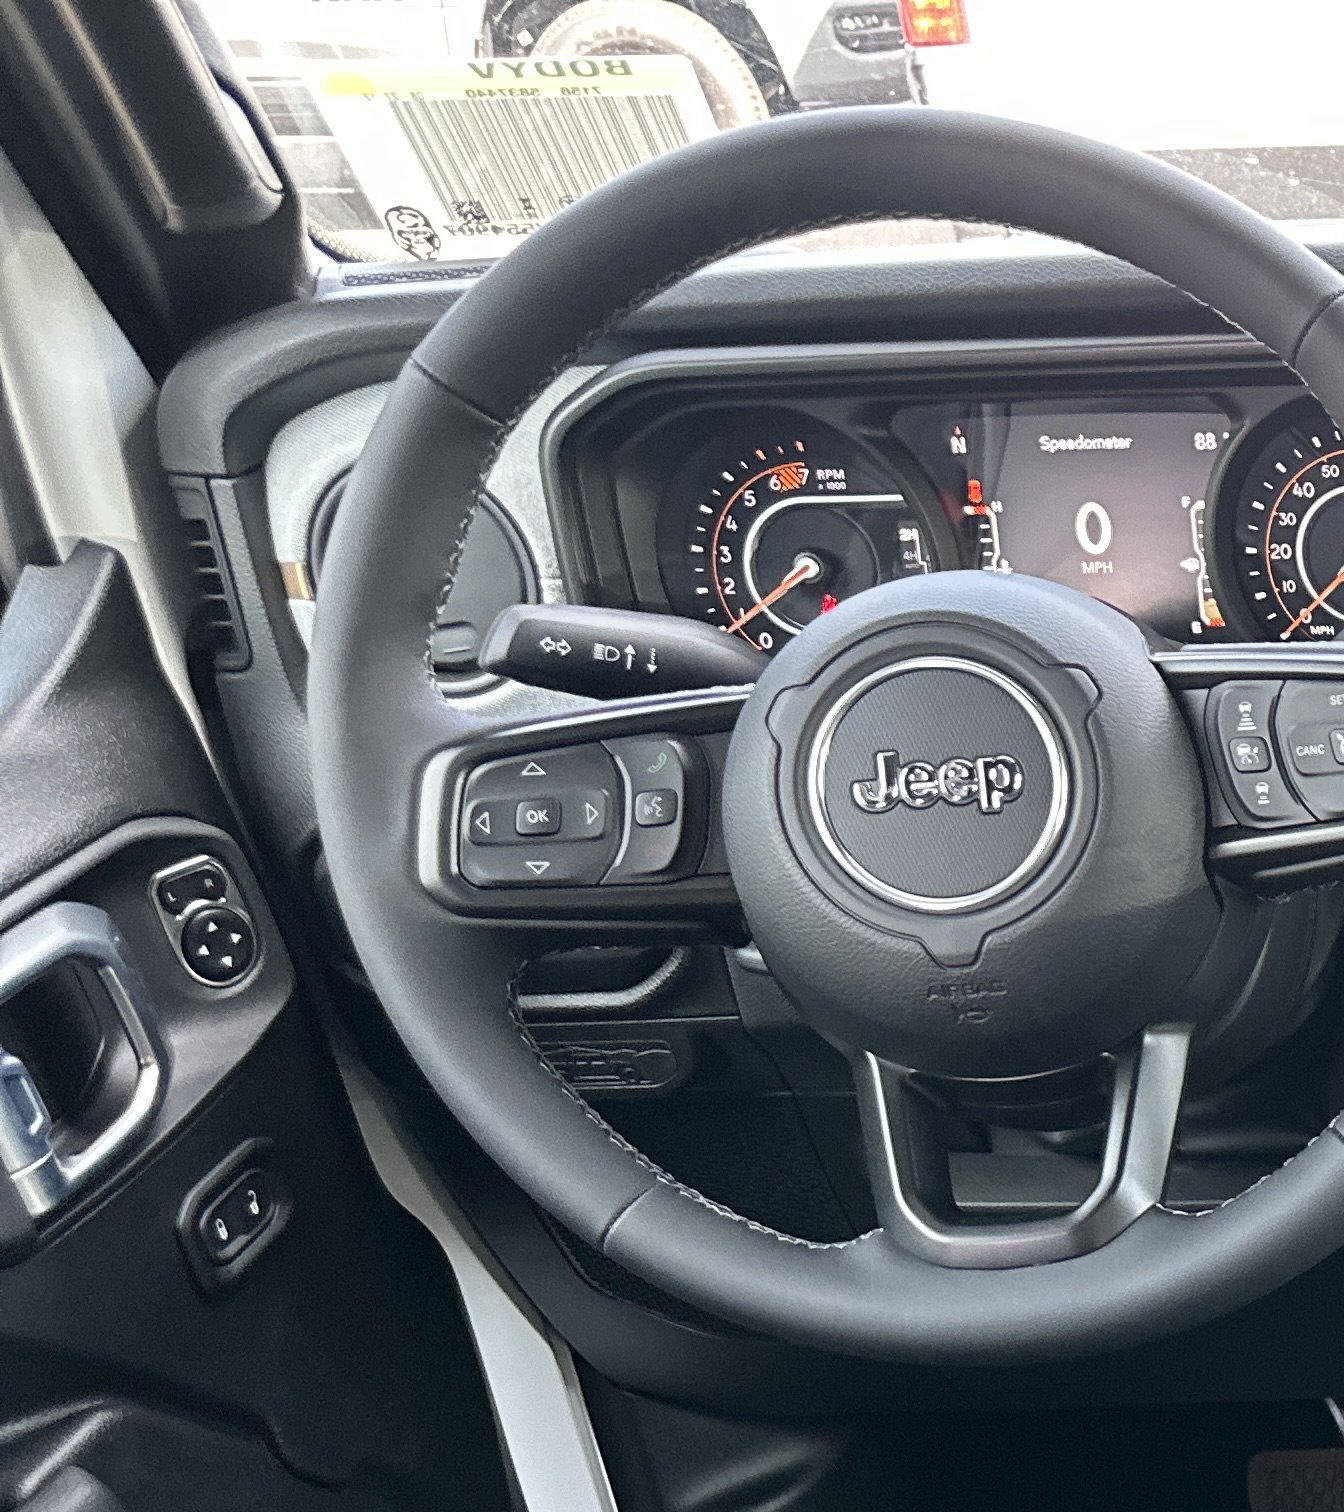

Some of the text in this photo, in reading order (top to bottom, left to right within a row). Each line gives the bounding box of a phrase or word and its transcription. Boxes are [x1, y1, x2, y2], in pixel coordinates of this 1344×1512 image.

[950, 436, 967, 454] N
[1038, 433, 1133, 454] Speedometer
[798, 468, 810, 487] 7
[816, 469, 846, 481] RPM
[1321, 465, 1340, 479] 50
[769, 474, 782, 491] 6
[1292, 481, 1315, 499] 40
[744, 489, 757, 508] 5
[726, 515, 738, 532] 4
[1279, 512, 1297, 526] 30
[1075, 501, 1112, 555] 0
[719, 546, 732, 563] 3
[1269, 543, 1293, 560] 20
[1081, 561, 1114, 574] MPH
[723, 577, 736, 595] 2
[1282, 580, 1296, 593] 10
[1310, 625, 1335, 636] MPH
[759, 632, 773, 650] 0
[1296, 743, 1325, 757] CANC
[852, 749, 1025, 814] Jeep
[525, 807, 549, 825] OK
